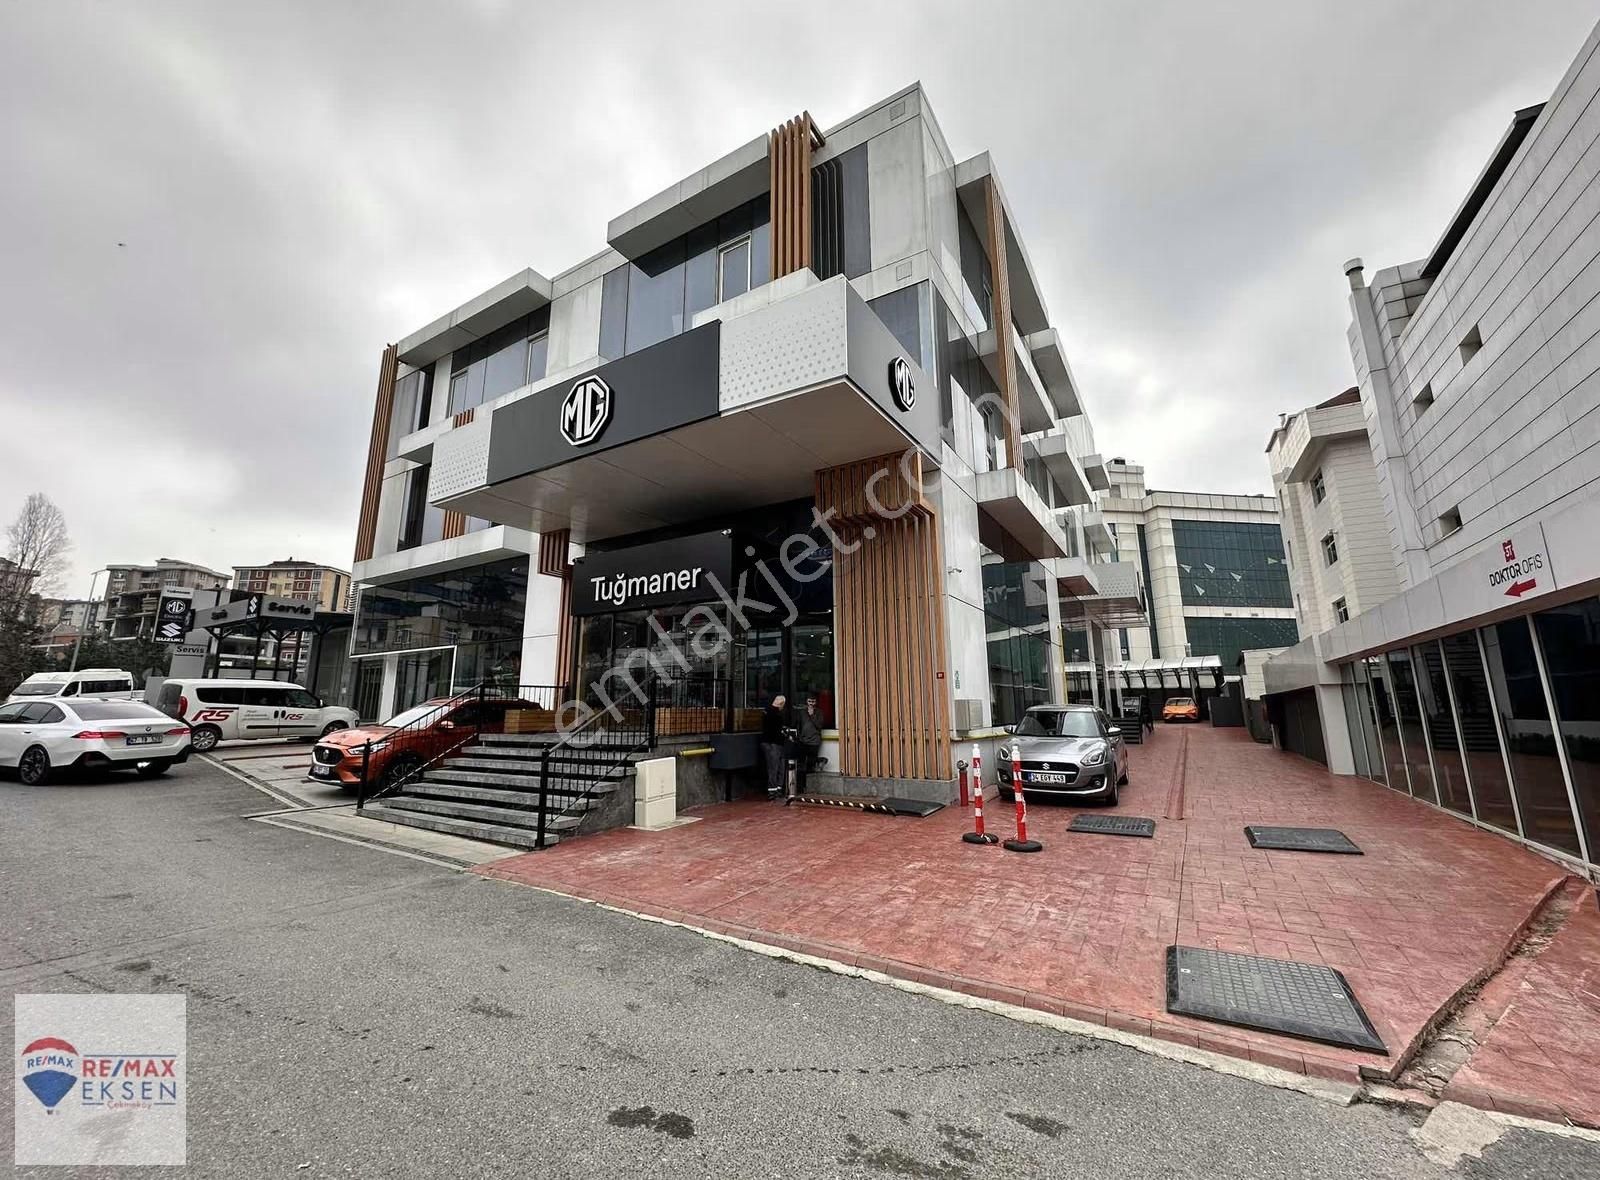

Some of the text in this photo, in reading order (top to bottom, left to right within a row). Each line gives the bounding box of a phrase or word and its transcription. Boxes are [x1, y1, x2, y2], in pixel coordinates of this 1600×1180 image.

[896, 360, 915, 409] MG
[563, 378, 607, 441] MG
[590, 567, 701, 605] Tuğmaner
[1489, 563, 1522, 587] DOKTOR
[167, 601, 185, 613] MG
[268, 602, 311, 615] Servis
[191, 710, 234, 722] RS
